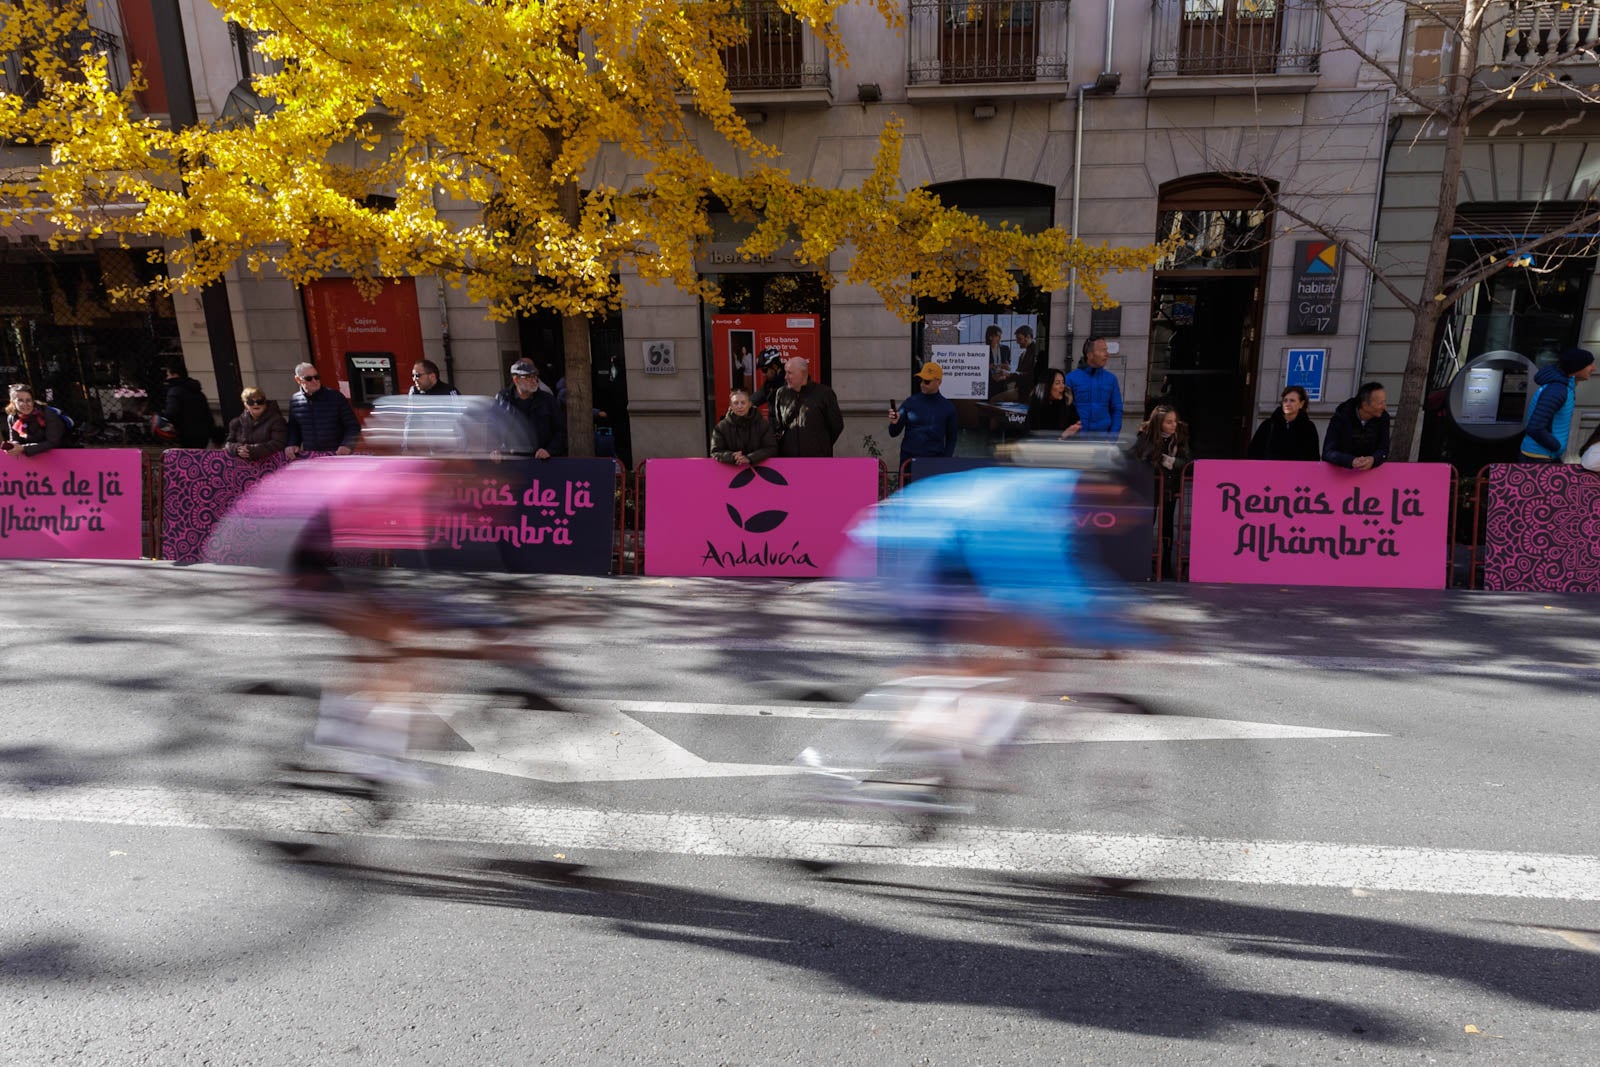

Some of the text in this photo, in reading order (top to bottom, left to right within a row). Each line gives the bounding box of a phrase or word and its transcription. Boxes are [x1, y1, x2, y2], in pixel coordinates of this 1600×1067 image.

[1297, 281, 1336, 294] habitat
[1299, 301, 1332, 314] Gran
[1316, 317, 1330, 332] 17
[1293, 354, 1319, 371] AT
[701, 540, 818, 568] Andalucía
